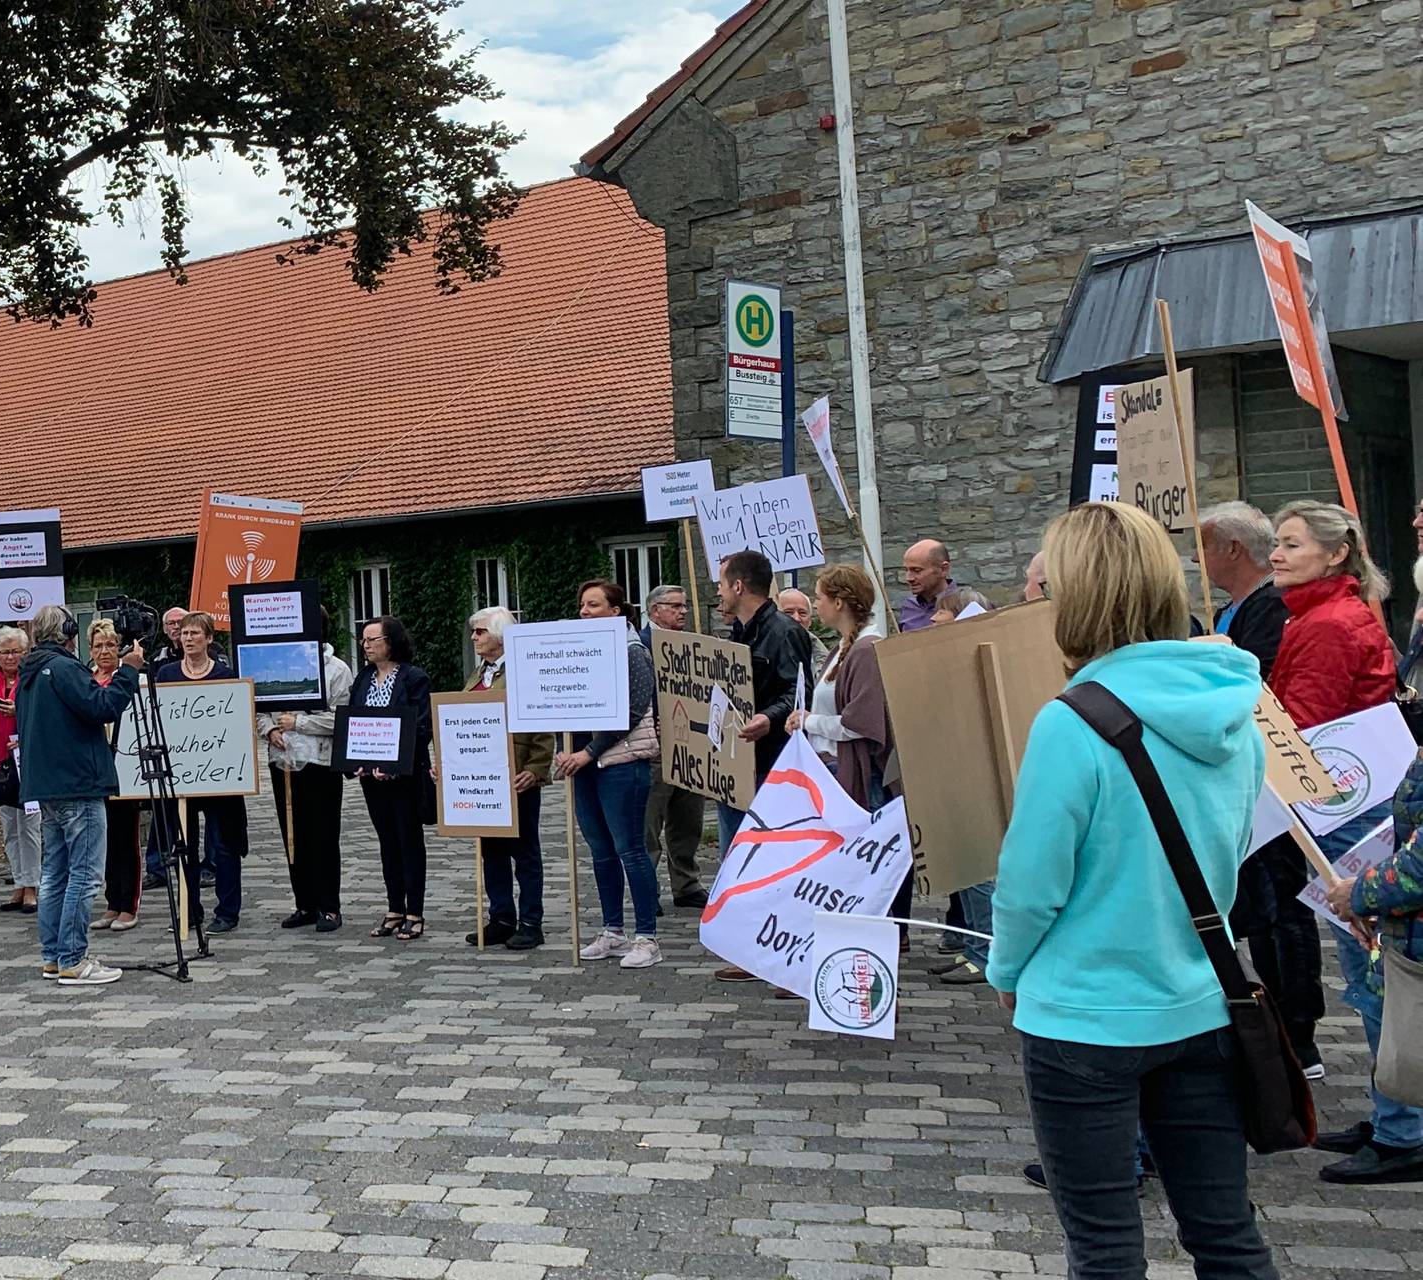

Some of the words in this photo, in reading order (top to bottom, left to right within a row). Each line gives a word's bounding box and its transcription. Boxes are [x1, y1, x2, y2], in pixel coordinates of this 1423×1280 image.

[746, 305, 765, 336] H
[733, 355, 776, 369] Bürgerhaus
[736, 369, 767, 384] Bussteig
[729, 395, 743, 405] 657
[730, 410, 735, 419] E
[701, 496, 736, 521] Wir
[740, 491, 790, 517] haben
[1135, 482, 1187, 530] Bürger
[215, 512, 237, 520] KRANK
[237, 514, 258, 522] DURCH
[711, 531, 732, 546] nur
[735, 517, 747, 541] 1
[753, 512, 807, 539] Leben
[759, 532, 824, 564] NATUR
[526, 649, 564, 660] Infraschall
[566, 648, 603, 658] schwächt
[661, 642, 692, 675] Stadt
[539, 665, 589, 675] menschliches
[540, 683, 589, 693] Herzgewebe.
[169, 698, 188, 719] ist
[445, 718, 459, 726] Erst
[461, 718, 481, 727] jeden
[483, 717, 501, 725] Cent
[459, 746, 489, 755] gespart.
[671, 744, 704, 790] Alles
[452, 801, 502, 810] HOCH-Verrat!
[794, 877, 865, 914] unser
[818, 964, 832, 1013] WINDWAHN
